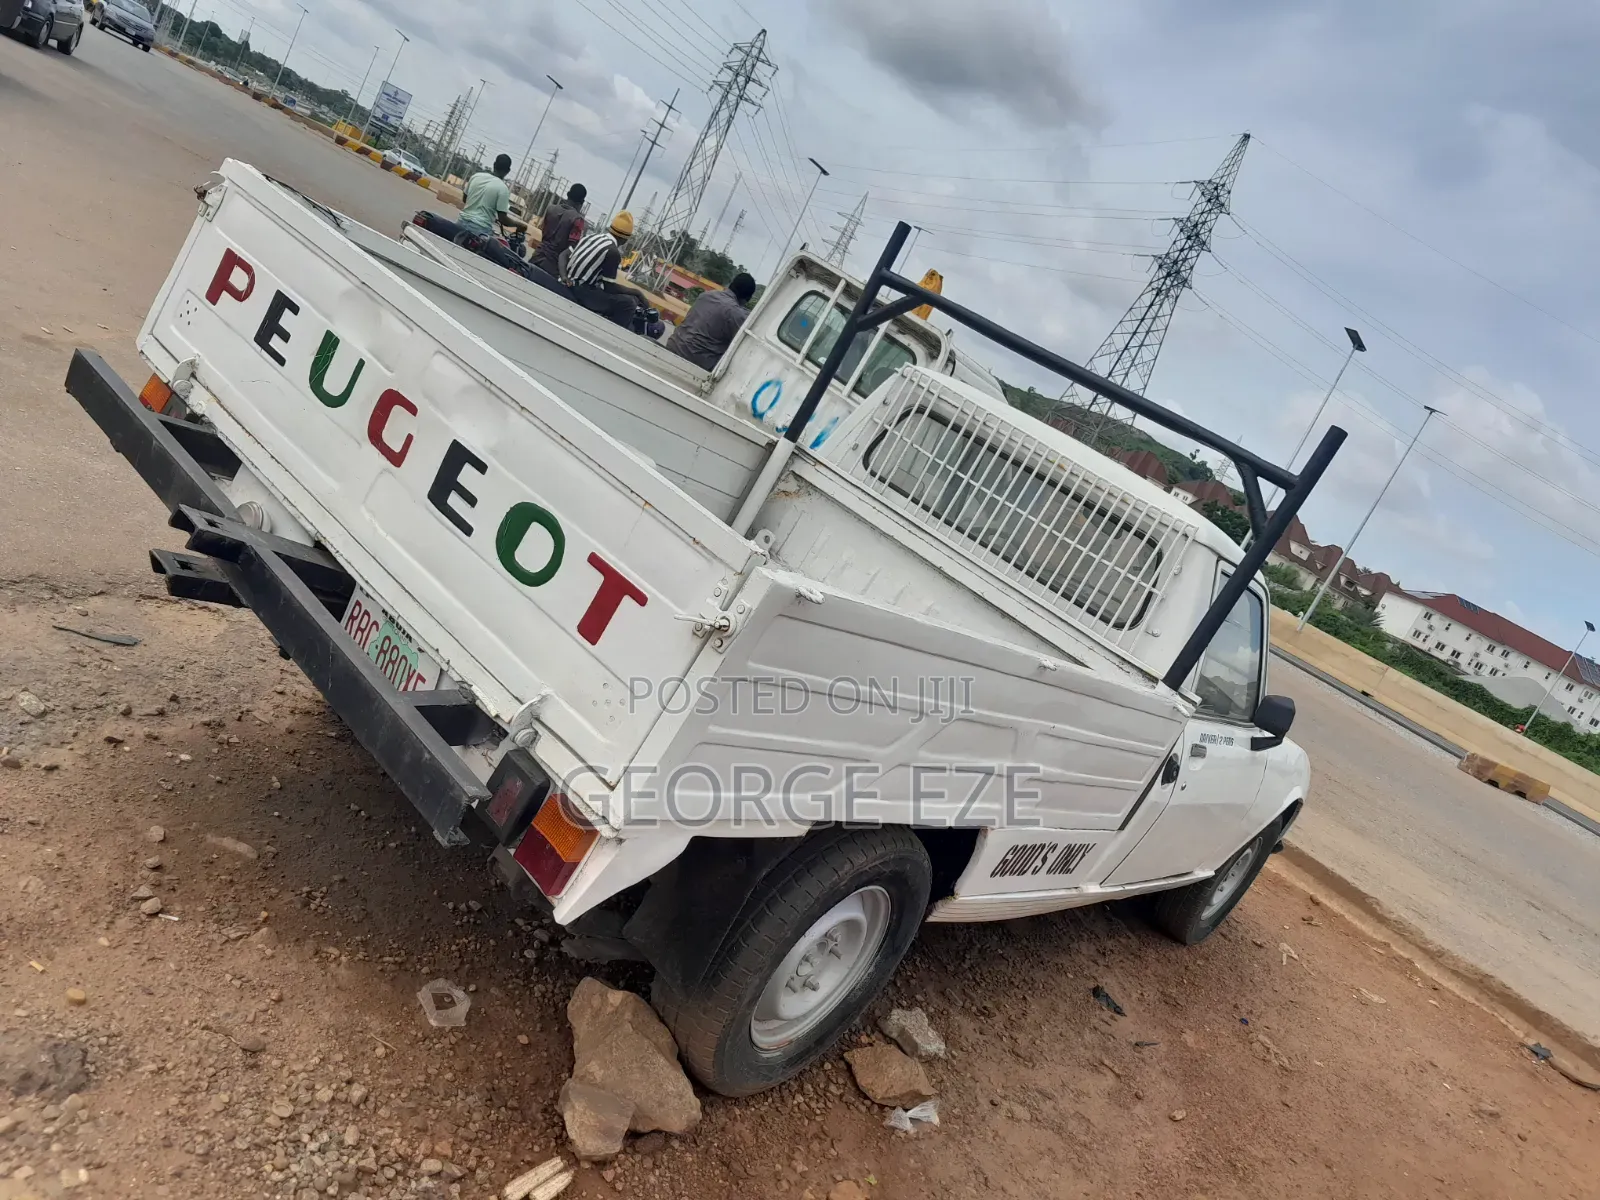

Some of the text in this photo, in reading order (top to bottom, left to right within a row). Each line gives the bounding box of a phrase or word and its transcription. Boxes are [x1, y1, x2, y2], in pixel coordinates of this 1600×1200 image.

[205, 247, 648, 646] PEUGEOT
[989, 841, 1097, 879] GOOD'S ONLY
